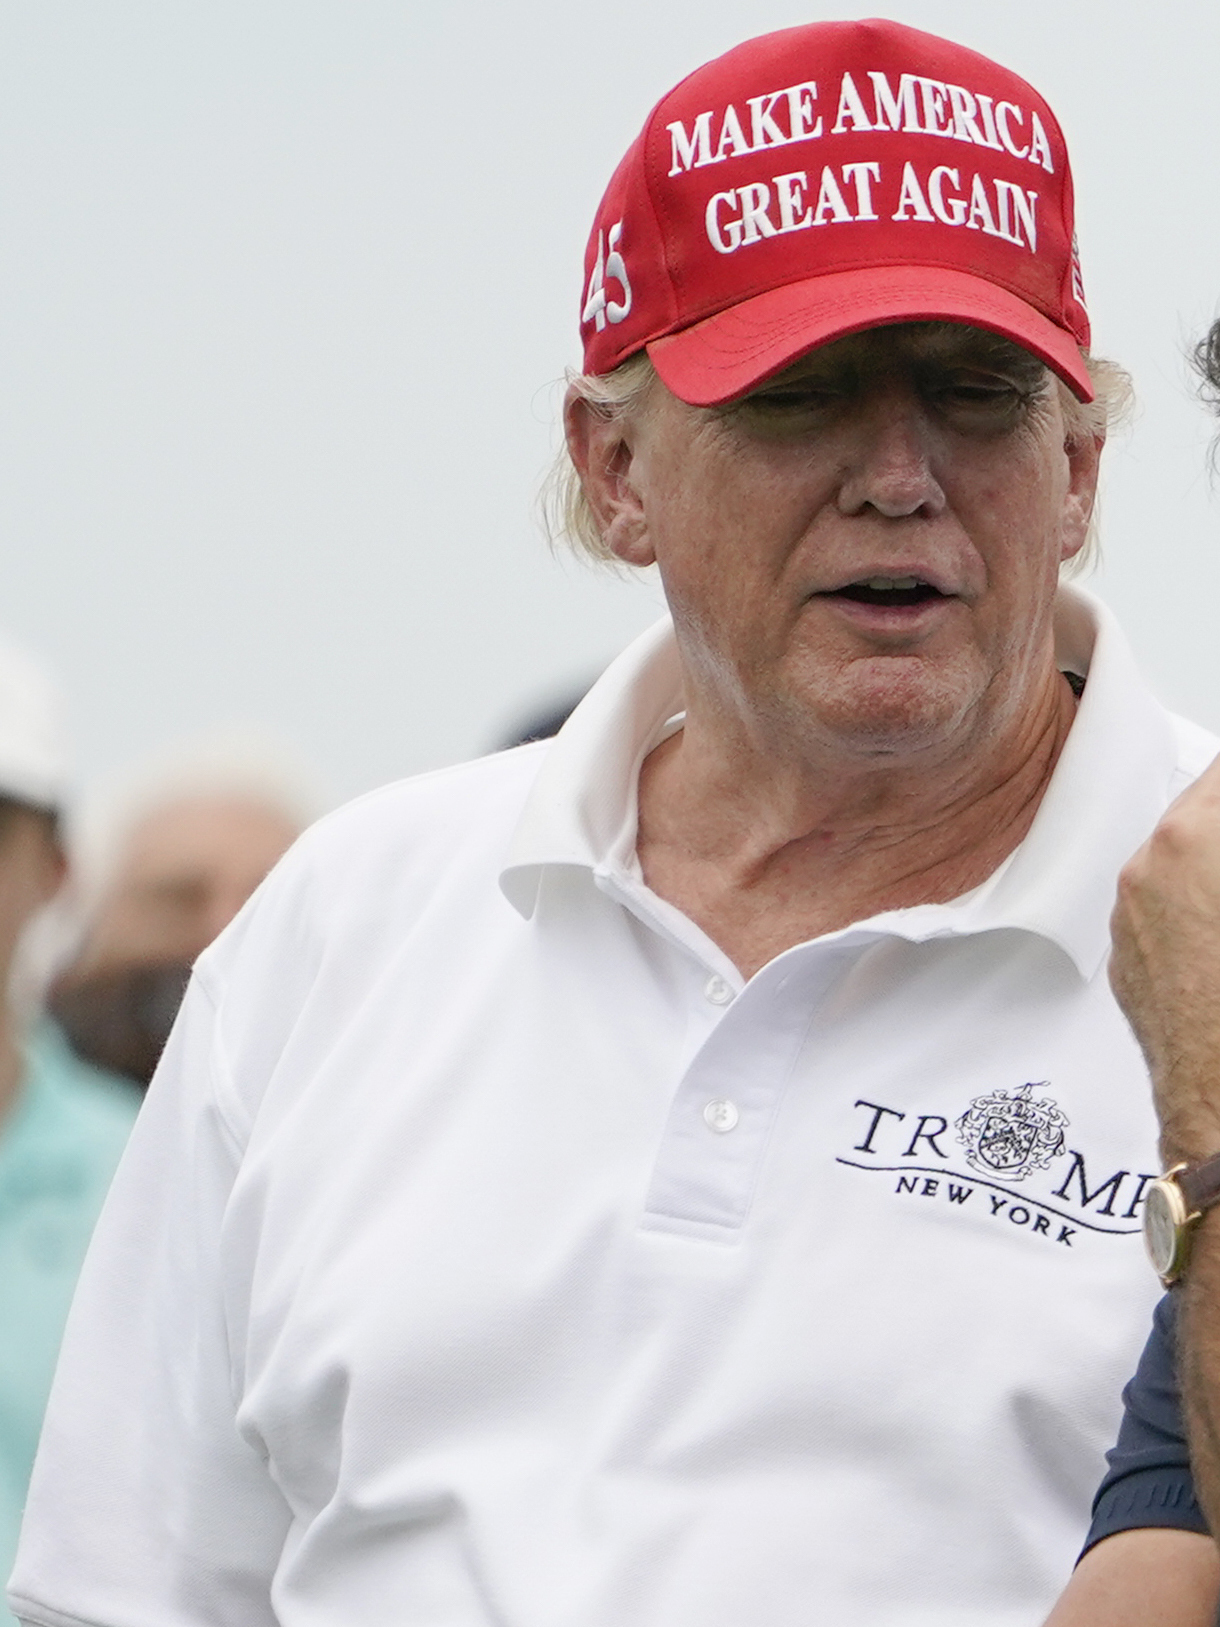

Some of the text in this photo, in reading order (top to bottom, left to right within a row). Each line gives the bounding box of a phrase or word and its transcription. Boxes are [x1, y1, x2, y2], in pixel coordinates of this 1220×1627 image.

[666, 71, 1055, 178] MAKE AMERICA
[704, 161, 1039, 255] GREAT AGAIN
[582, 216, 632, 333] 45
[894, 1176, 1078, 1247] NEW YORK
